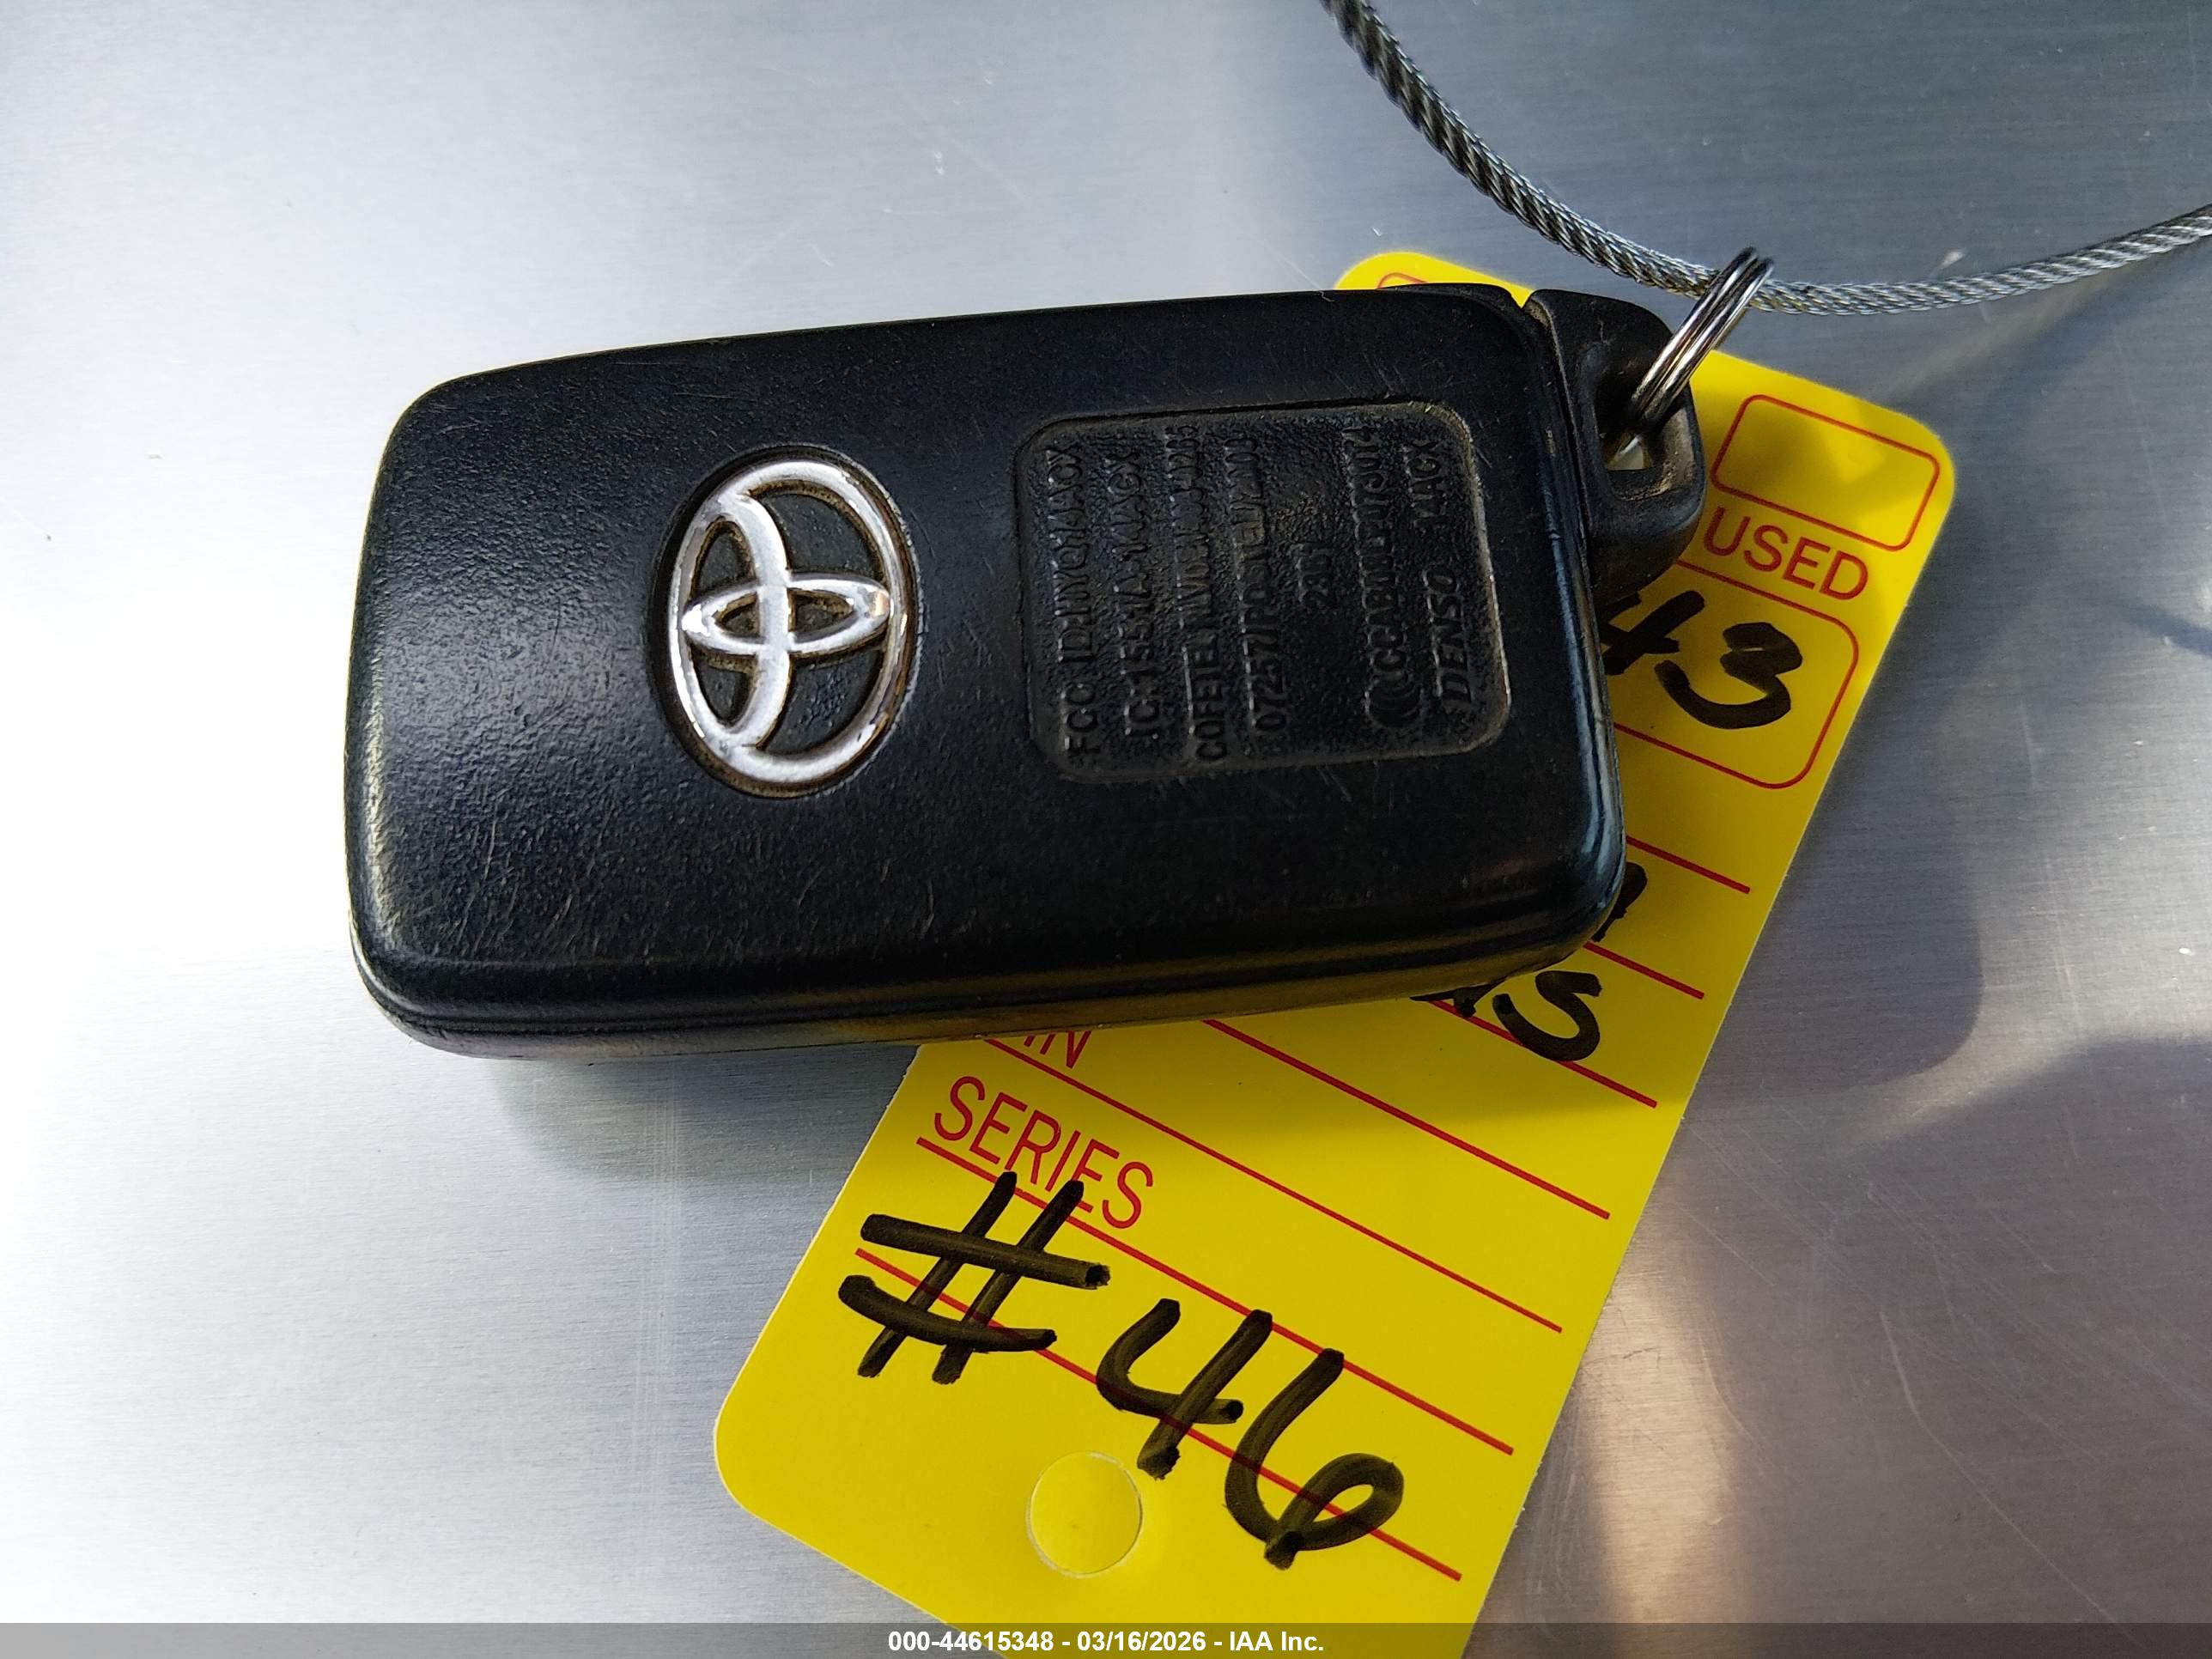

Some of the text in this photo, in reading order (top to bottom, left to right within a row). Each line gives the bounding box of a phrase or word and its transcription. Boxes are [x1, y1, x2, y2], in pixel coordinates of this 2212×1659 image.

[1403, 441, 1469, 704] DENSO 14ACX
[1703, 507, 1869, 600] USED
[1065, 683, 1100, 754] FCC
[934, 1076, 1153, 1230] SERIES
